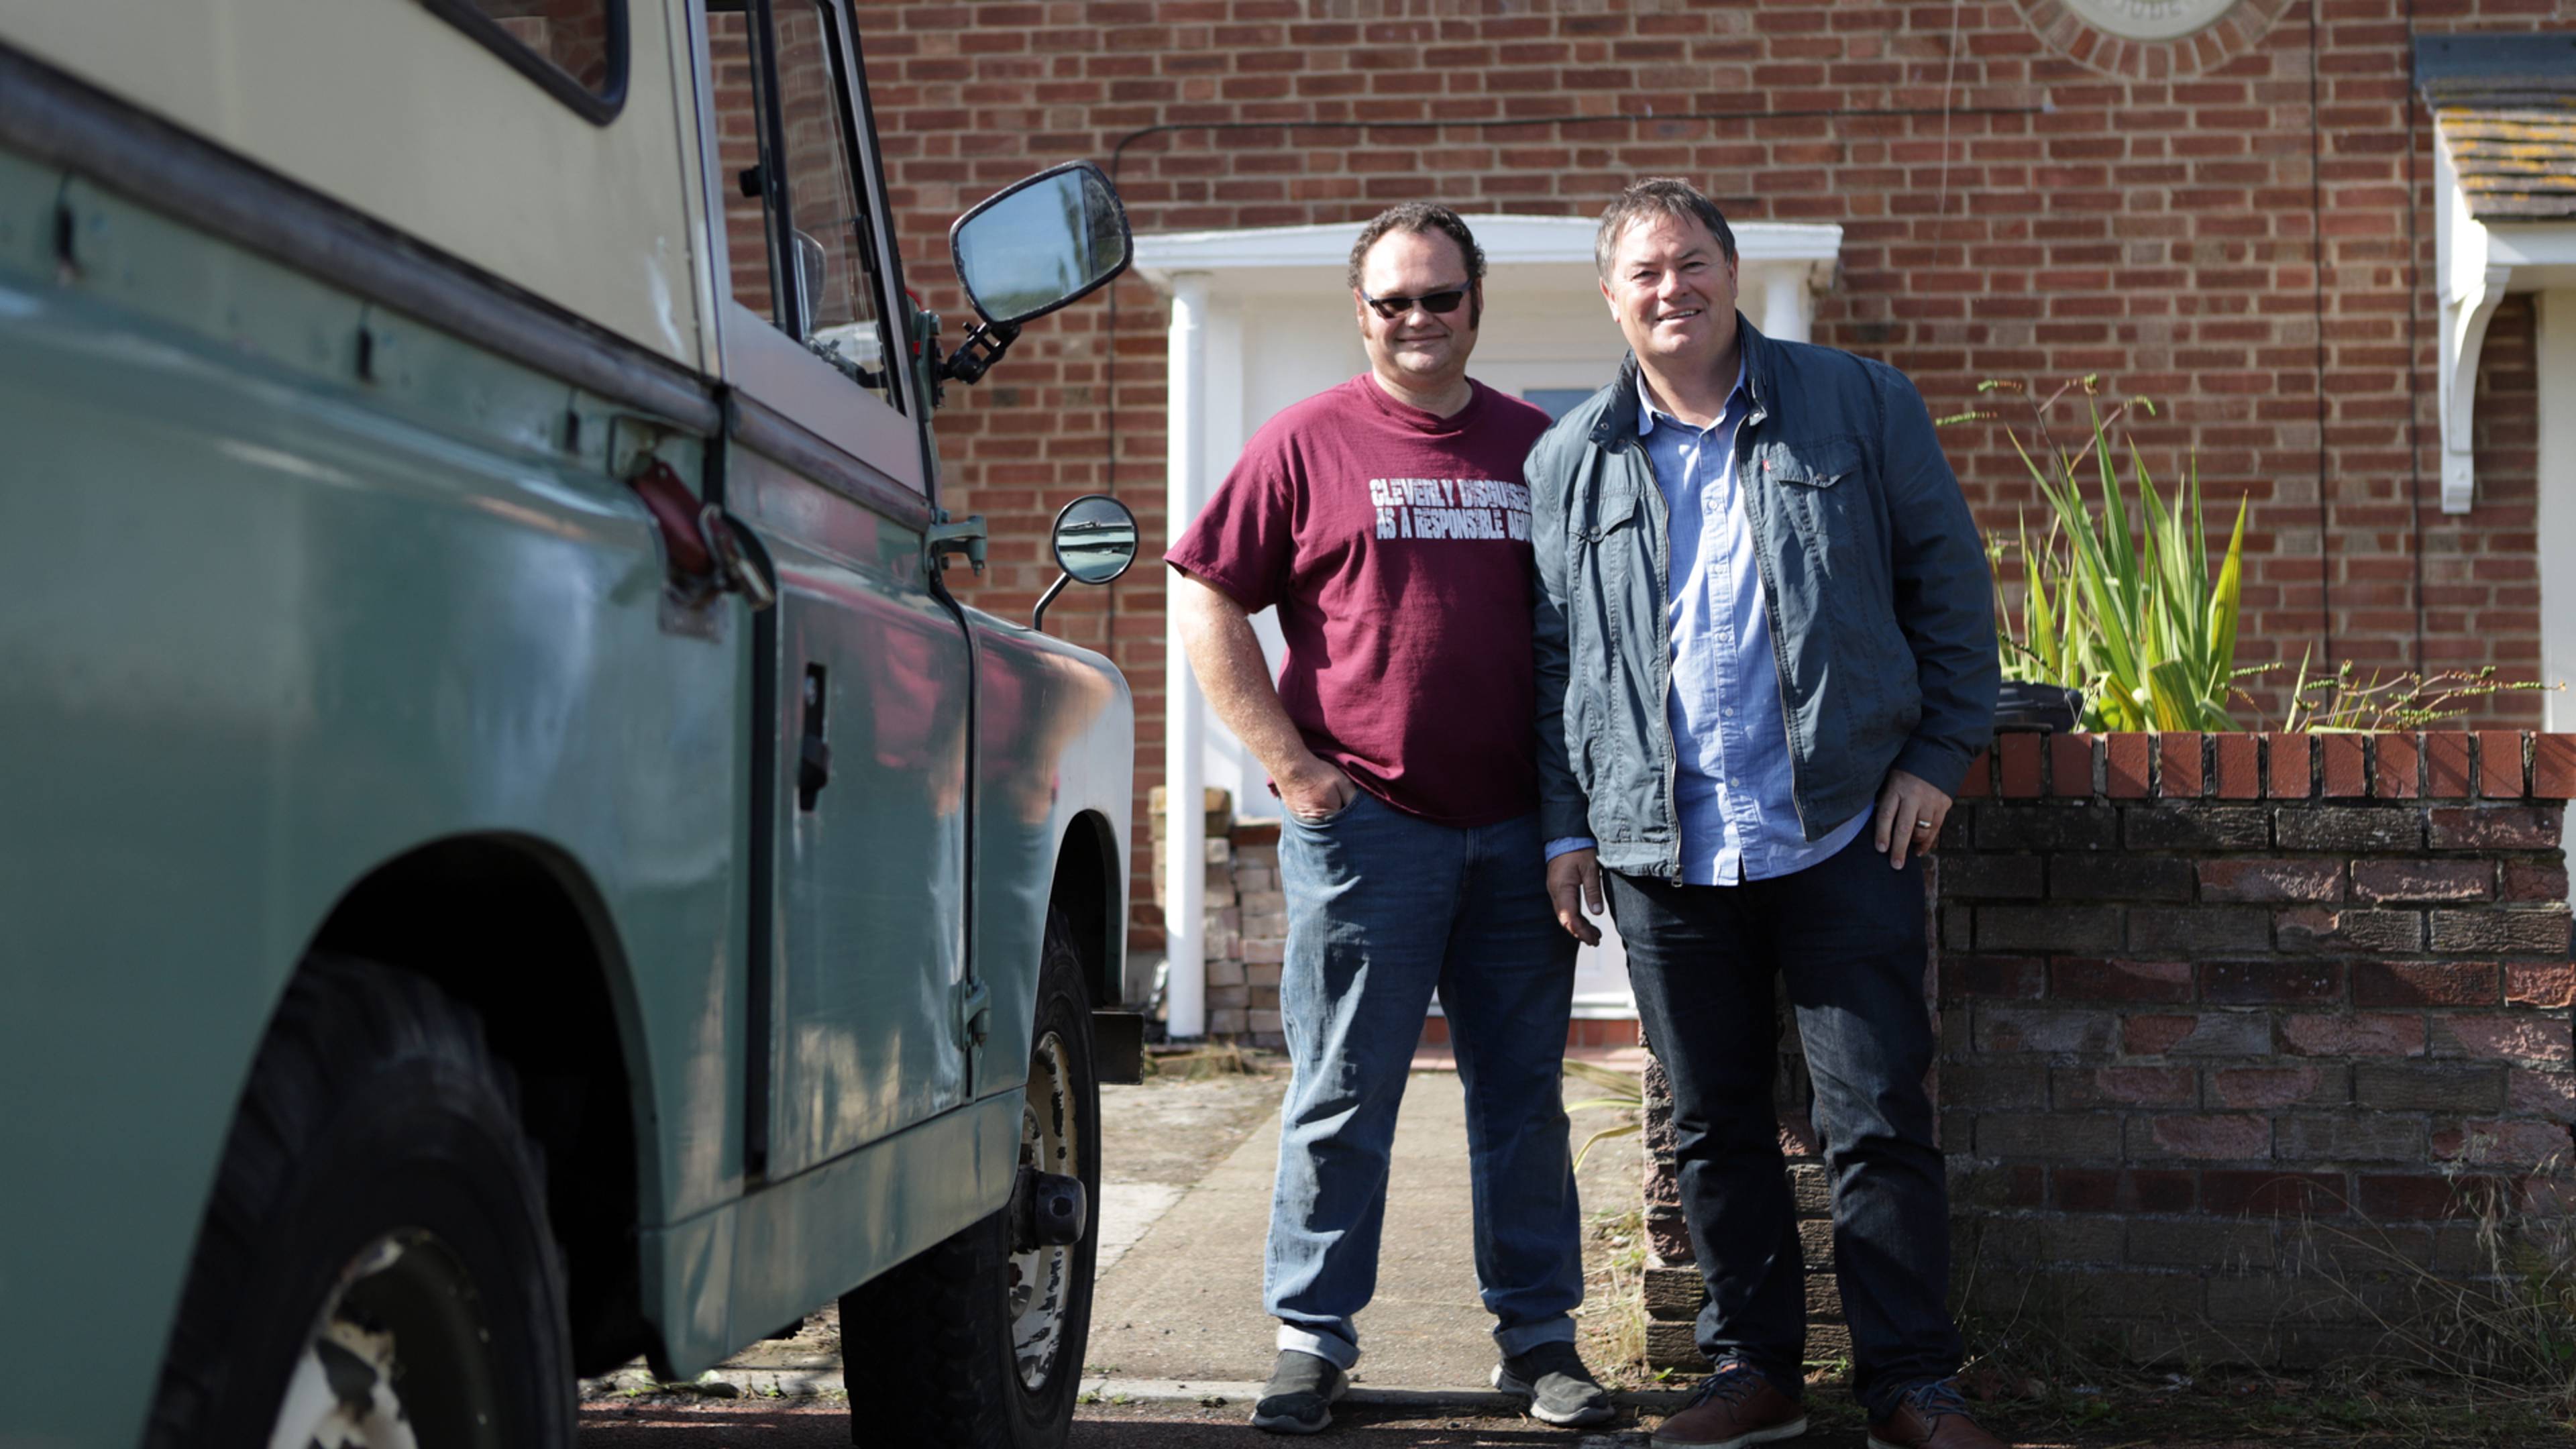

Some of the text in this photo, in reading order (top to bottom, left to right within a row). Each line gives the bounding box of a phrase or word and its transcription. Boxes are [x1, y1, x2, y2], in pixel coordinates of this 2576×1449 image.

[1369, 478, 1531, 513] CLEVERLY DISGUISE
[1376, 506, 1532, 542] AS A RESPONSIBLE ADU
